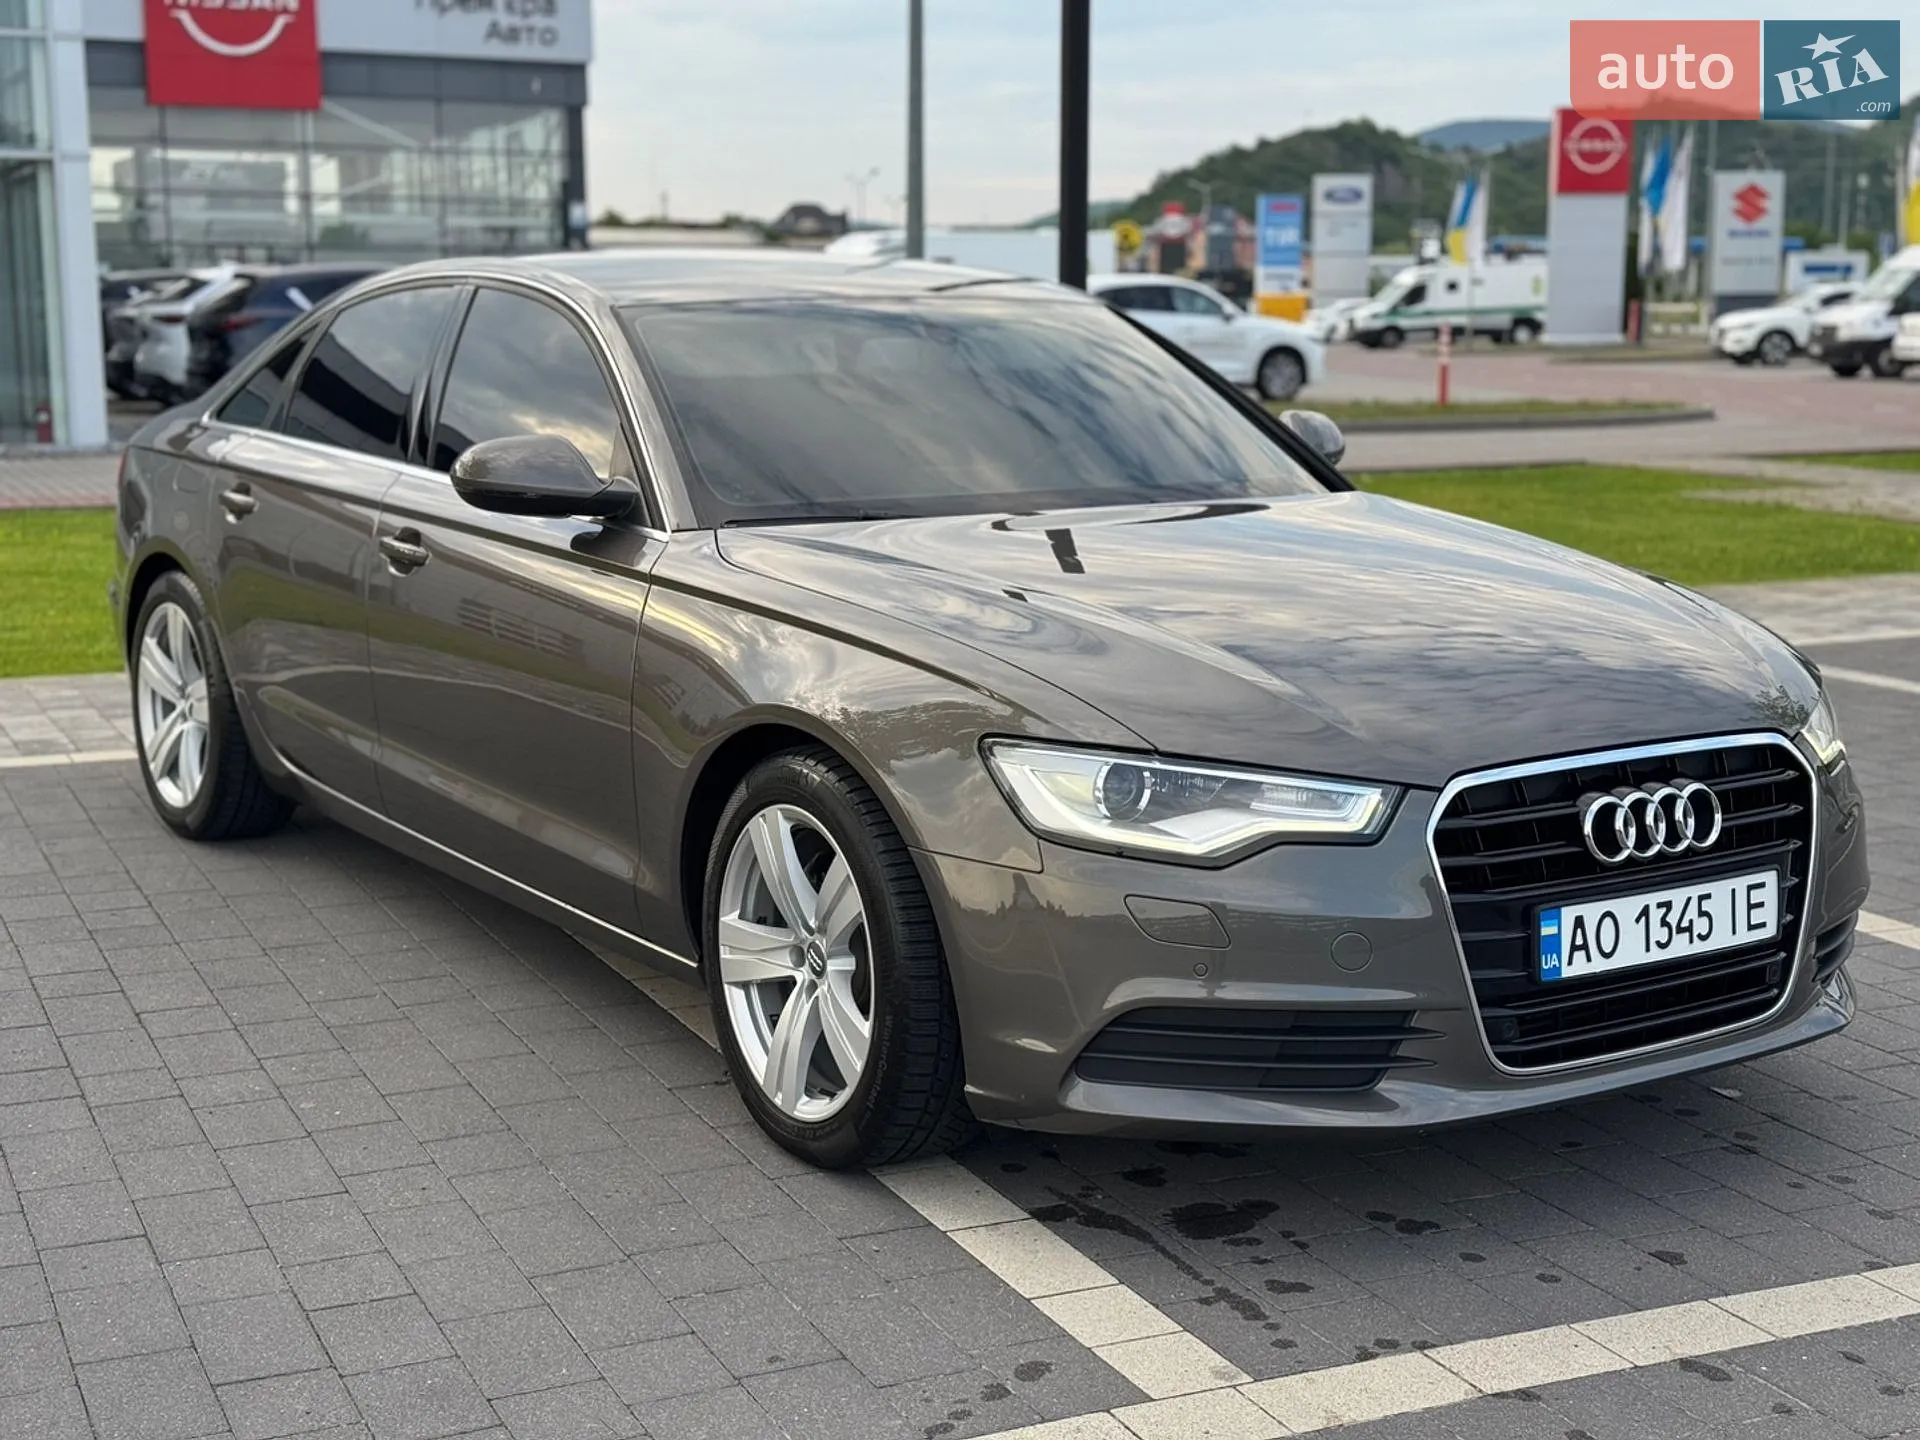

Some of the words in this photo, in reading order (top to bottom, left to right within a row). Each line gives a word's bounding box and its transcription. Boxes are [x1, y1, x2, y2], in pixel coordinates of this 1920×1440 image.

[1567, 910, 1620, 966] AO
[1634, 893, 1713, 953] 1345
[1731, 881, 1767, 935] IE
[1542, 954, 1560, 970] UA
